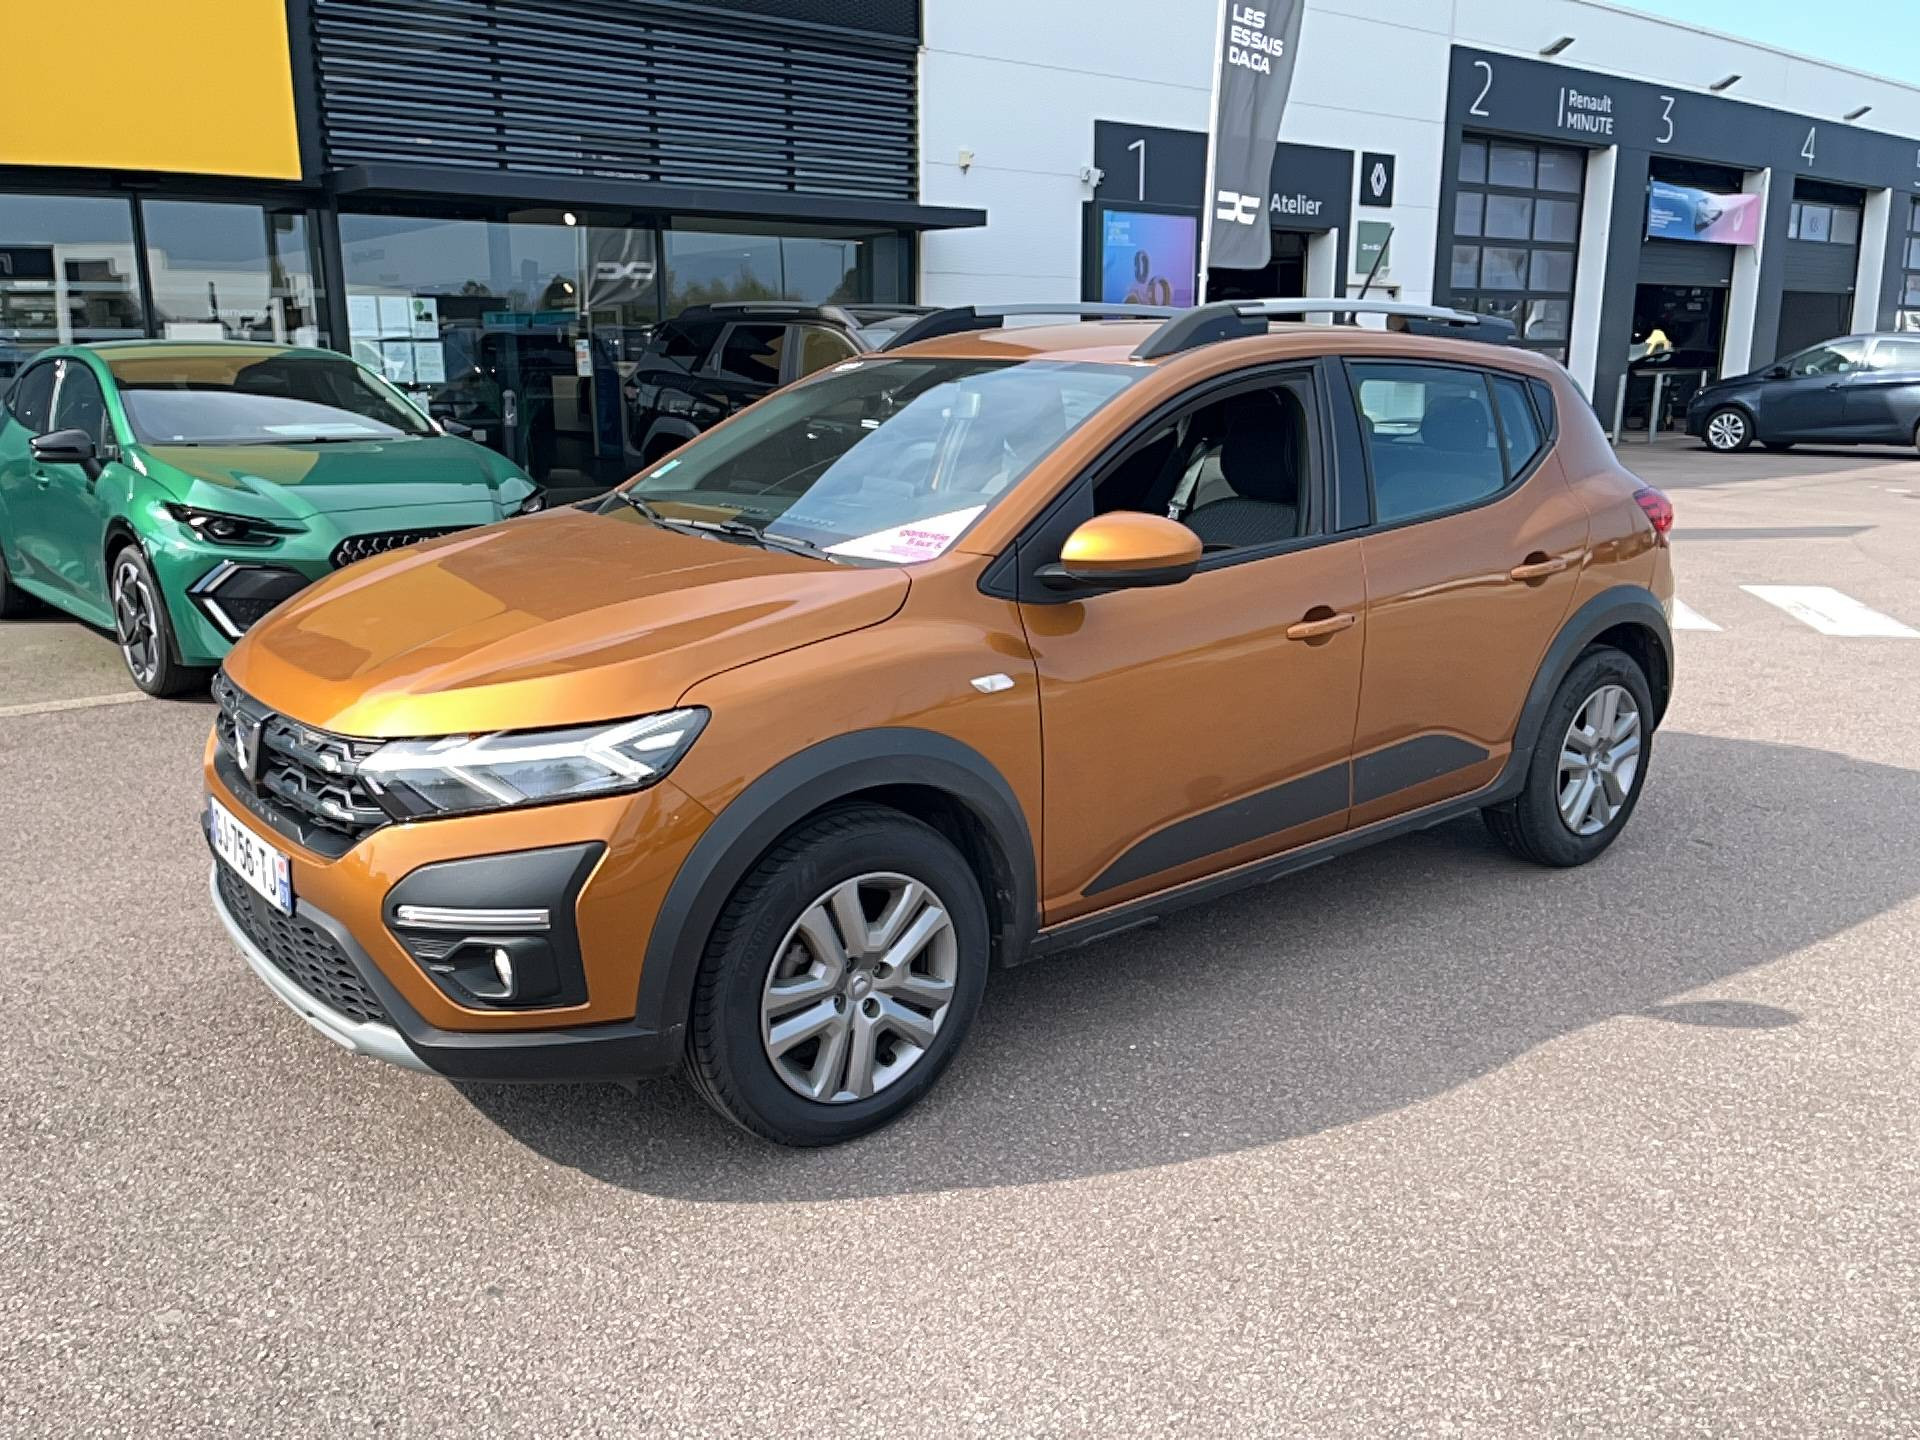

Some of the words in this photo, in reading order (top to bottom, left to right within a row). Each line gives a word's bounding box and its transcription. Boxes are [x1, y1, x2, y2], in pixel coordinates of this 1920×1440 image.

[1233, 4, 1266, 29] LES
[1231, 25, 1283, 57] ESSAIS
[1470, 61, 1492, 116] 2
[1568, 89, 1612, 113] Renault
[1567, 111, 1614, 135] MINUTE
[1656, 95, 1675, 143] 3
[1801, 127, 1816, 167] 4
[1128, 139, 1146, 201] 1
[1270, 193, 1323, 215] Atelier
